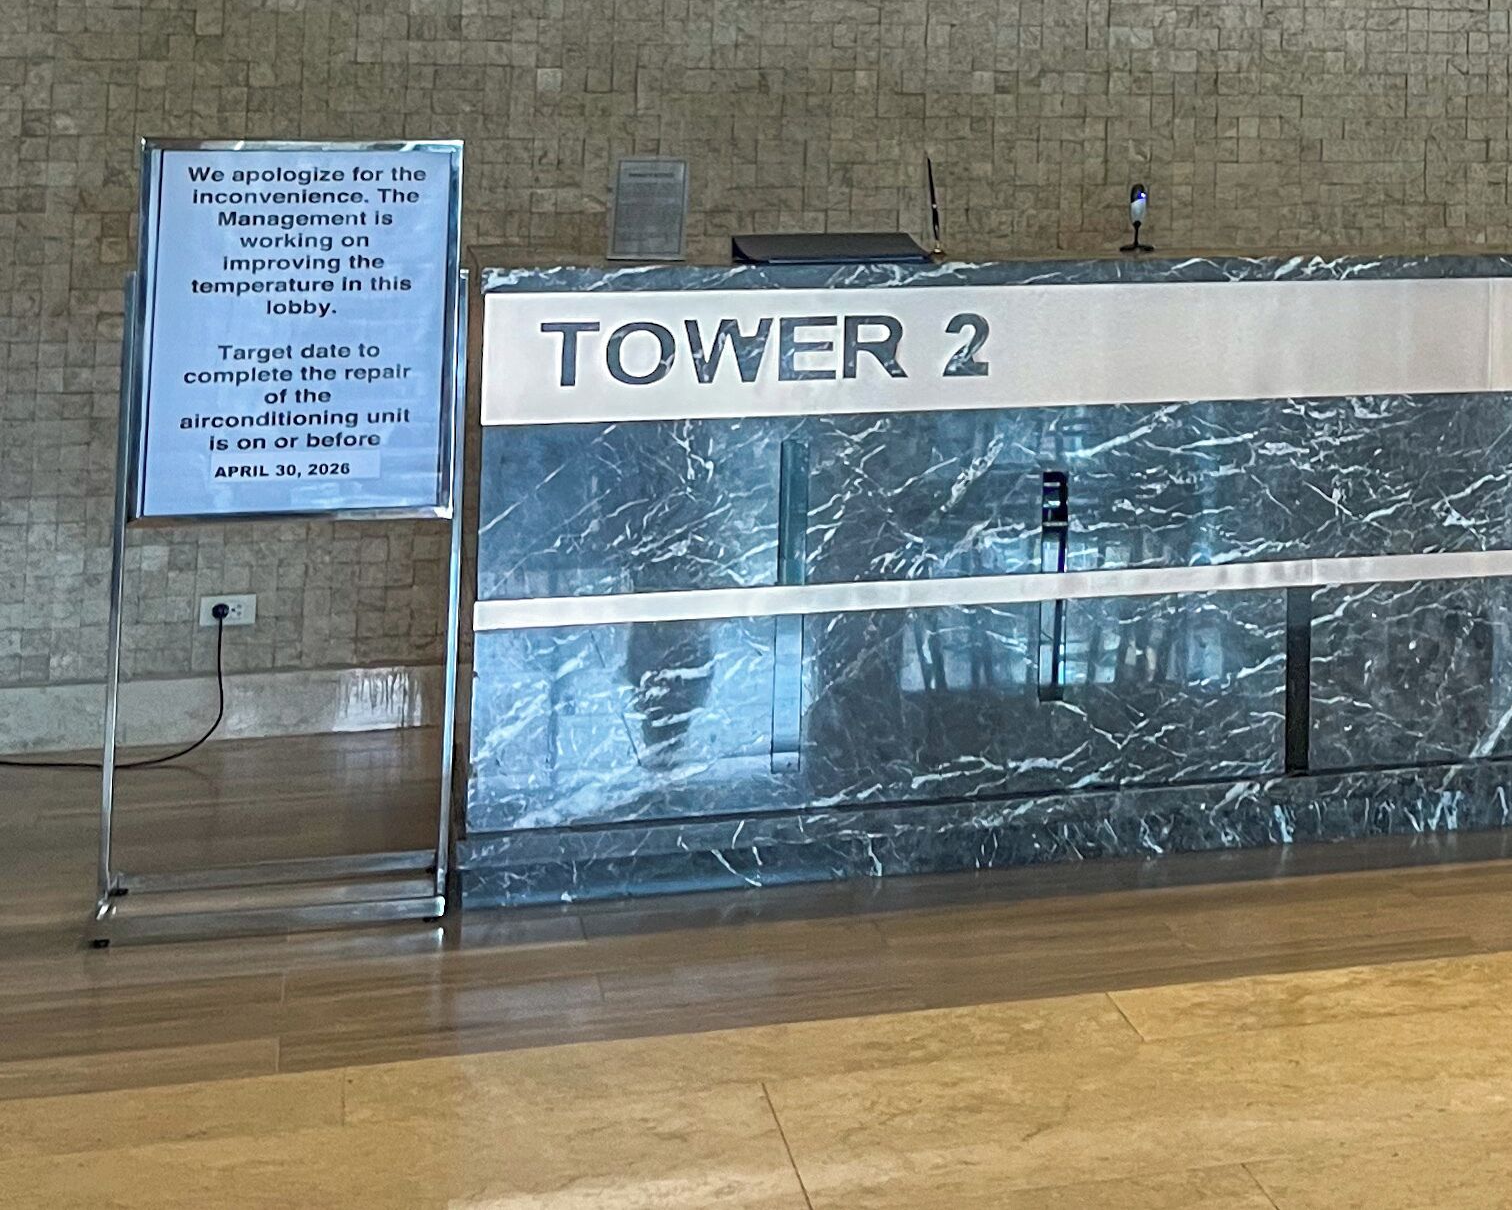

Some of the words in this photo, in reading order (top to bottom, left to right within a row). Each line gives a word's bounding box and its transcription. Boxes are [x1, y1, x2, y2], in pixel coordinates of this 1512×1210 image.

[188, 166, 225, 182] We
[232, 166, 345, 186] apologize
[352, 166, 384, 182] for
[391, 166, 426, 182] the
[193, 188, 369, 204] inconvenience.
[377, 188, 420, 204] The
[218, 211, 367, 230] Management
[375, 210, 393, 226] is
[239, 232, 333, 252] working
[340, 235, 369, 248] on
[223, 254, 341, 275] improving
[348, 254, 385, 270] the
[191, 278, 334, 297] temperature
[342, 276, 362, 292] in
[370, 275, 412, 291] this
[266, 298, 337, 318] lobby.
[217, 344, 292, 364] Target
[300, 343, 351, 359] date
[358, 343, 380, 358] to
[540, 314, 909, 387] TOWER
[942, 312, 990, 378] 2
[183, 366, 293, 387] complete
[300, 365, 337, 381] the
[345, 363, 412, 384] repair
[264, 388, 288, 405] of
[294, 388, 332, 404] the
[180, 409, 358, 429] airconditioning
[367, 407, 410, 424] unit
[209, 435, 229, 452] is
[236, 437, 266, 452] on
[274, 436, 299, 449] or
[306, 431, 381, 448] before
[214, 465, 270, 478] APRIL
[275, 464, 302, 479] 30,
[307, 462, 350, 476] 2026
